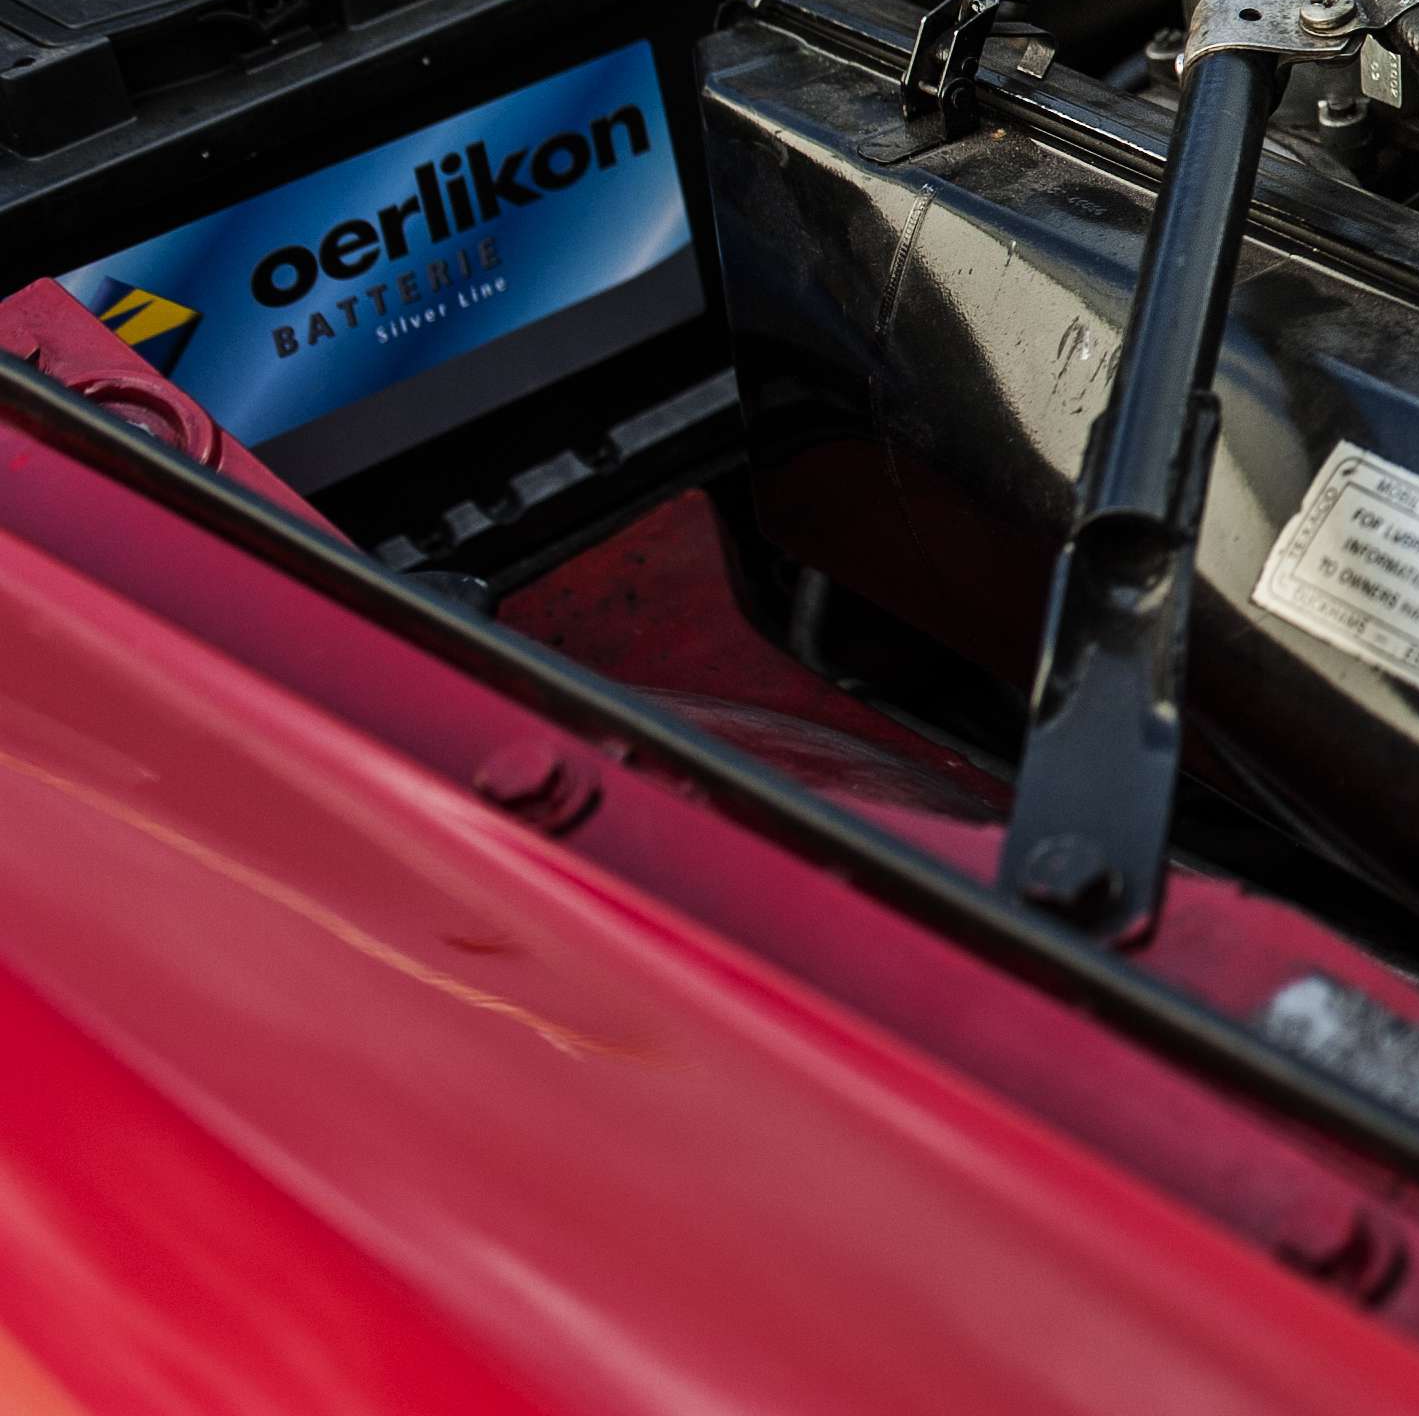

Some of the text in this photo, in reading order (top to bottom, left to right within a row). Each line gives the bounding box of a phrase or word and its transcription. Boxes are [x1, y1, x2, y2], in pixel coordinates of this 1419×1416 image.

[250, 103, 651, 308] oerlikon
[272, 235, 500, 359] BATTERIE
[375, 276, 508, 344] Silver Line
[1352, 506, 1384, 533] FOR
[1317, 555, 1340, 577] TO
[1336, 565, 1402, 610] OWNERS
